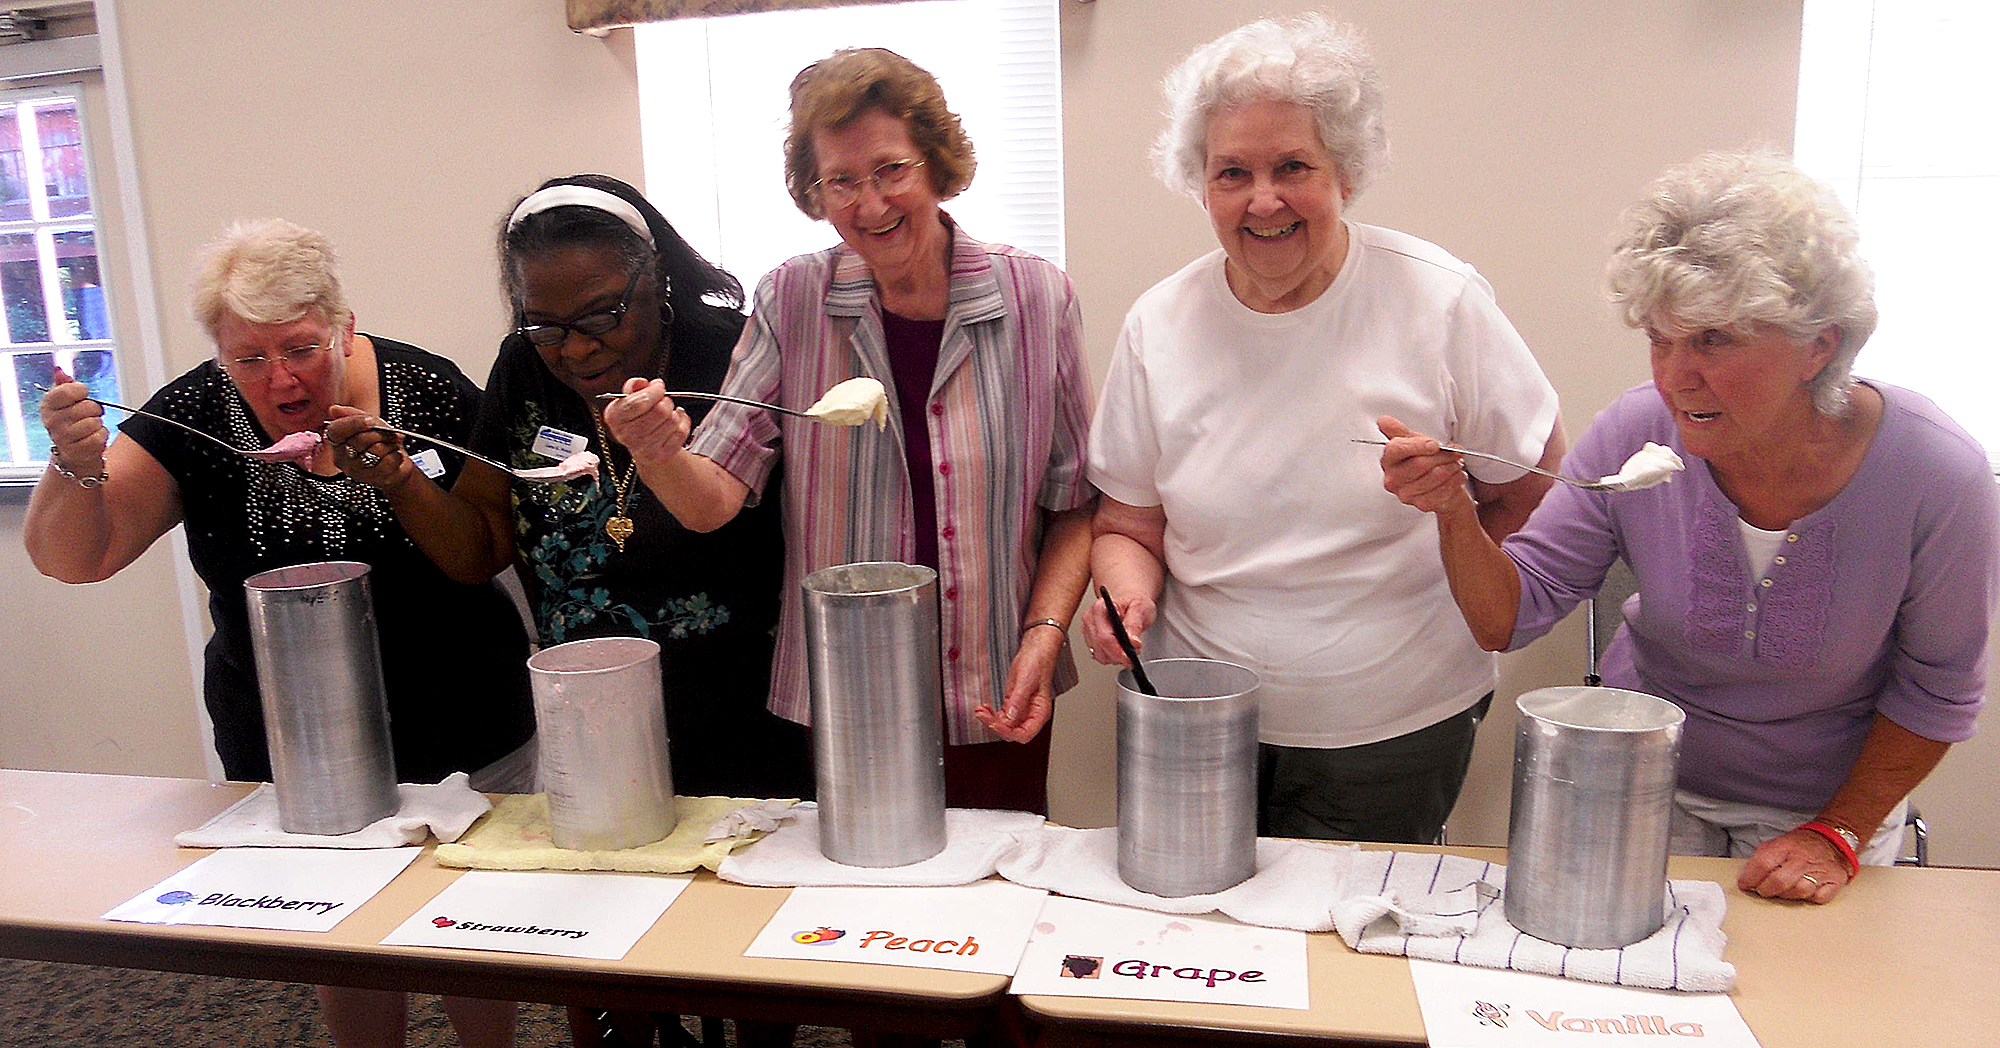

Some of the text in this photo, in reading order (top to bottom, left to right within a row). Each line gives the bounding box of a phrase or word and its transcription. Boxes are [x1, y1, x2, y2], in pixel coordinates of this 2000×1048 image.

[198, 893, 344, 915] Blackberry
[455, 921, 589, 939] Strawberry
[859, 930, 980, 957] Peach
[1112, 959, 1267, 987] Grape
[1526, 1009, 1705, 1038] Vanilla
